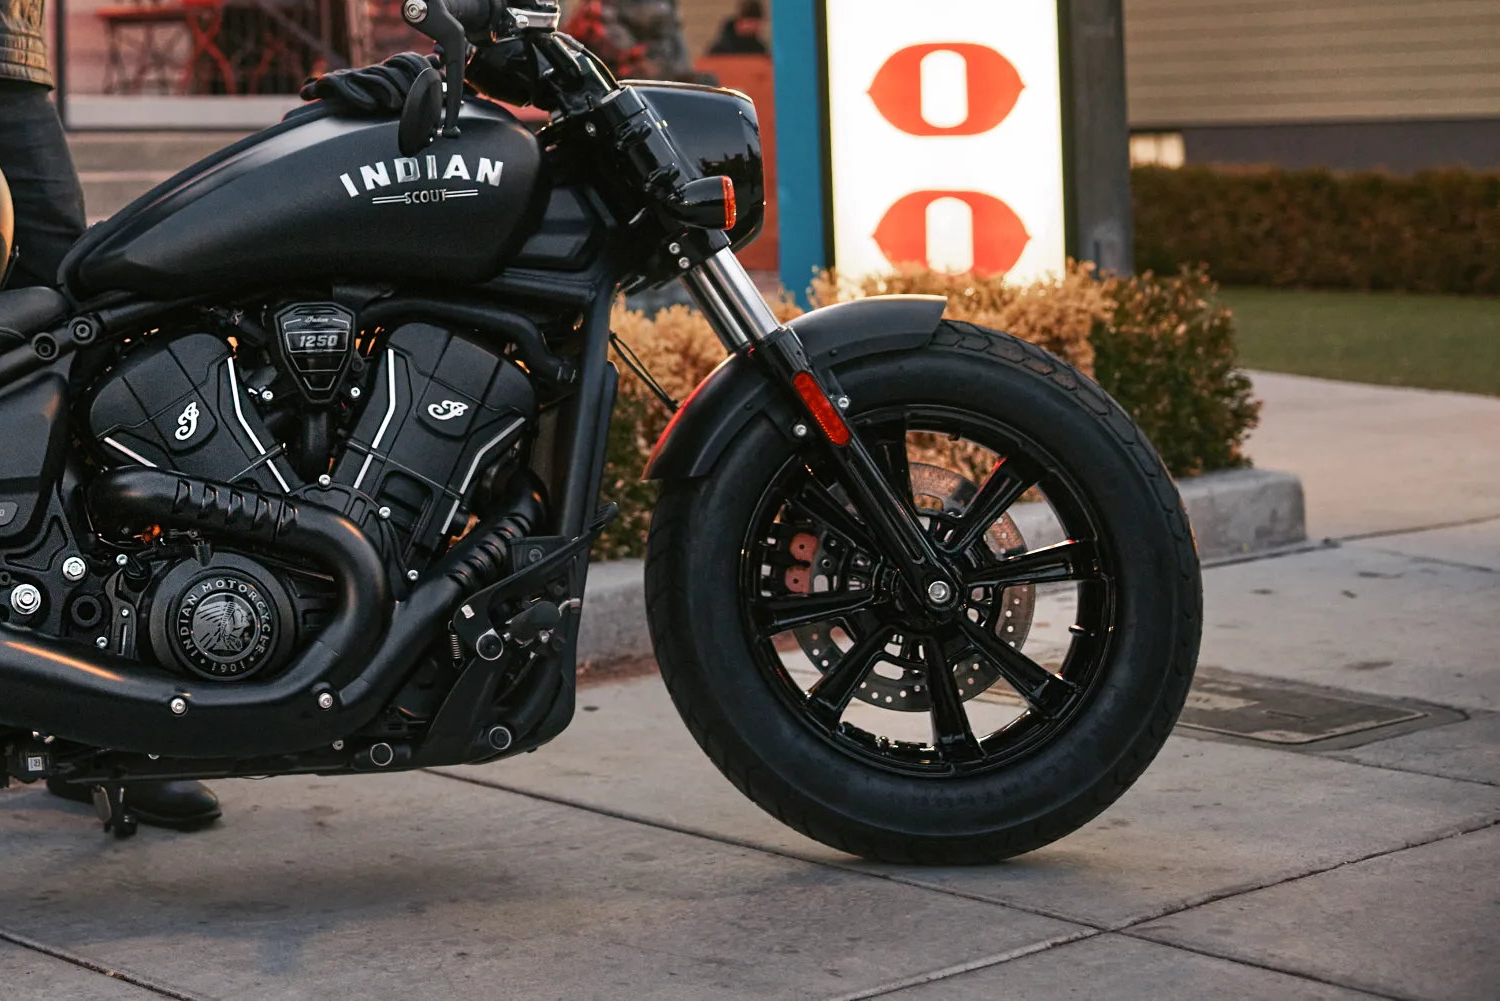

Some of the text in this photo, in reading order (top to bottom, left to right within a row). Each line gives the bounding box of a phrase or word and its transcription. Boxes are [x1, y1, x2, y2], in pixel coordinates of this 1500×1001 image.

[339, 154, 504, 198] INDIAN
[403, 188, 447, 205] SCOUT
[299, 334, 339, 348] 1250
[180, 579, 271, 658] INDIAN MOTORCYCLE
[211, 660, 246, 674] 1901
